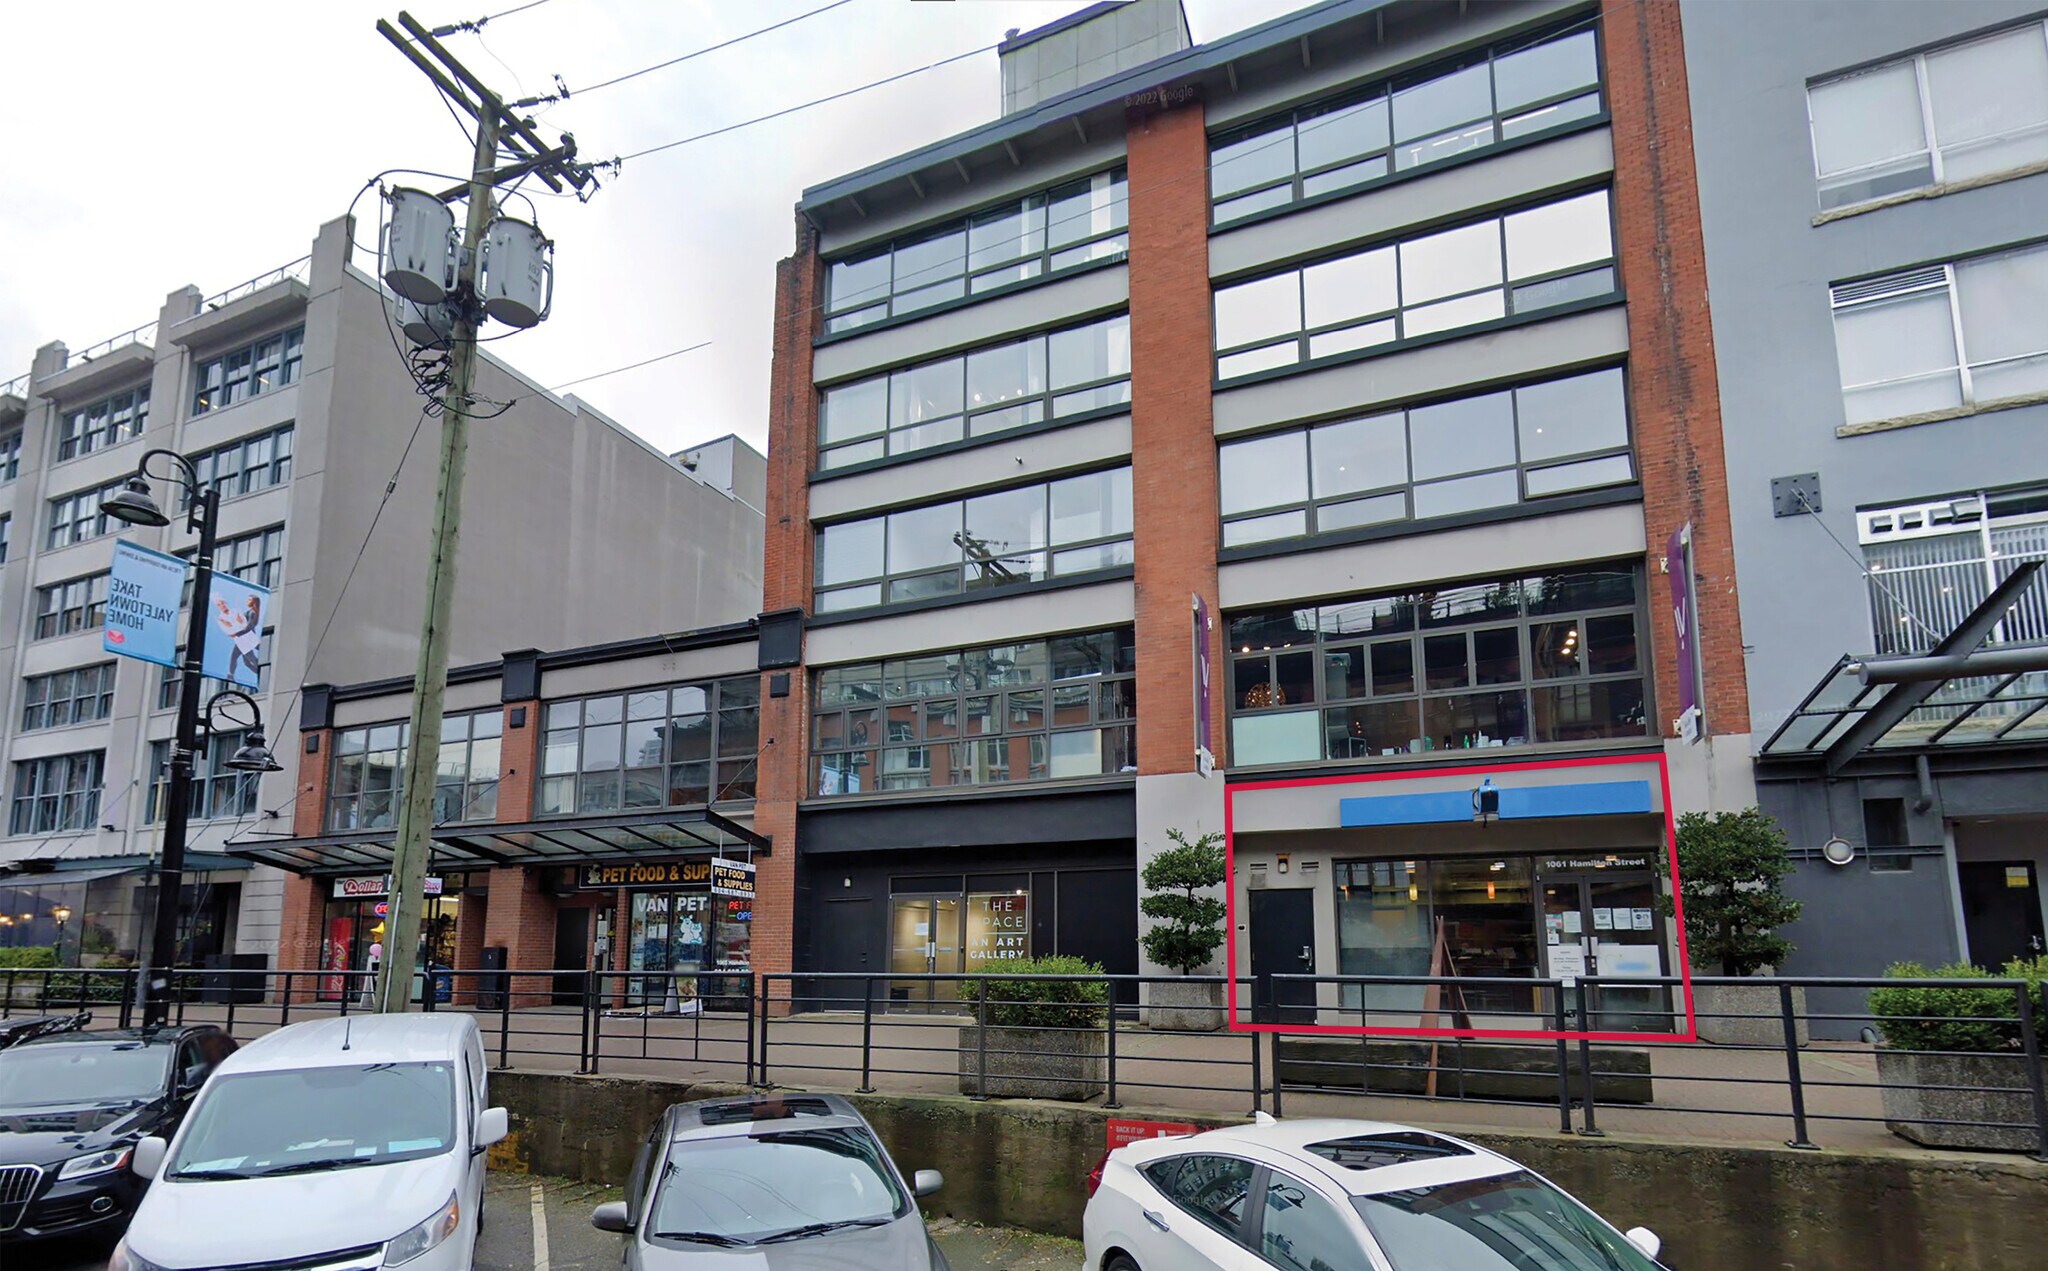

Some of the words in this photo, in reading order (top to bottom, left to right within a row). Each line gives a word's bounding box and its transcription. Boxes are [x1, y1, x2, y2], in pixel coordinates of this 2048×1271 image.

[1545, 860, 1567, 868] 1061
[1569, 859, 1612, 868] Hamilton
[1614, 858, 1646, 867] Street
[602, 867, 627, 883] PET
[630, 866, 665, 882] FOOD
[670, 865, 679, 880] &
[683, 864, 712, 880] SUP
[714, 866, 727, 877] PET
[728, 869, 746, 880] FOOD
[343, 878, 384, 895] Dollar
[717, 878, 723, 887] &
[723, 879, 753, 891] SUPPLIES
[636, 898, 669, 912] VAN
[677, 896, 708, 912] PET
[728, 901, 743, 910] PET
[982, 901, 1013, 912] THE
[736, 912, 752, 921] OPE
[982, 917, 1023, 928] PACE
[996, 937, 1024, 947] ART
[970, 950, 1025, 960] GALLERY
